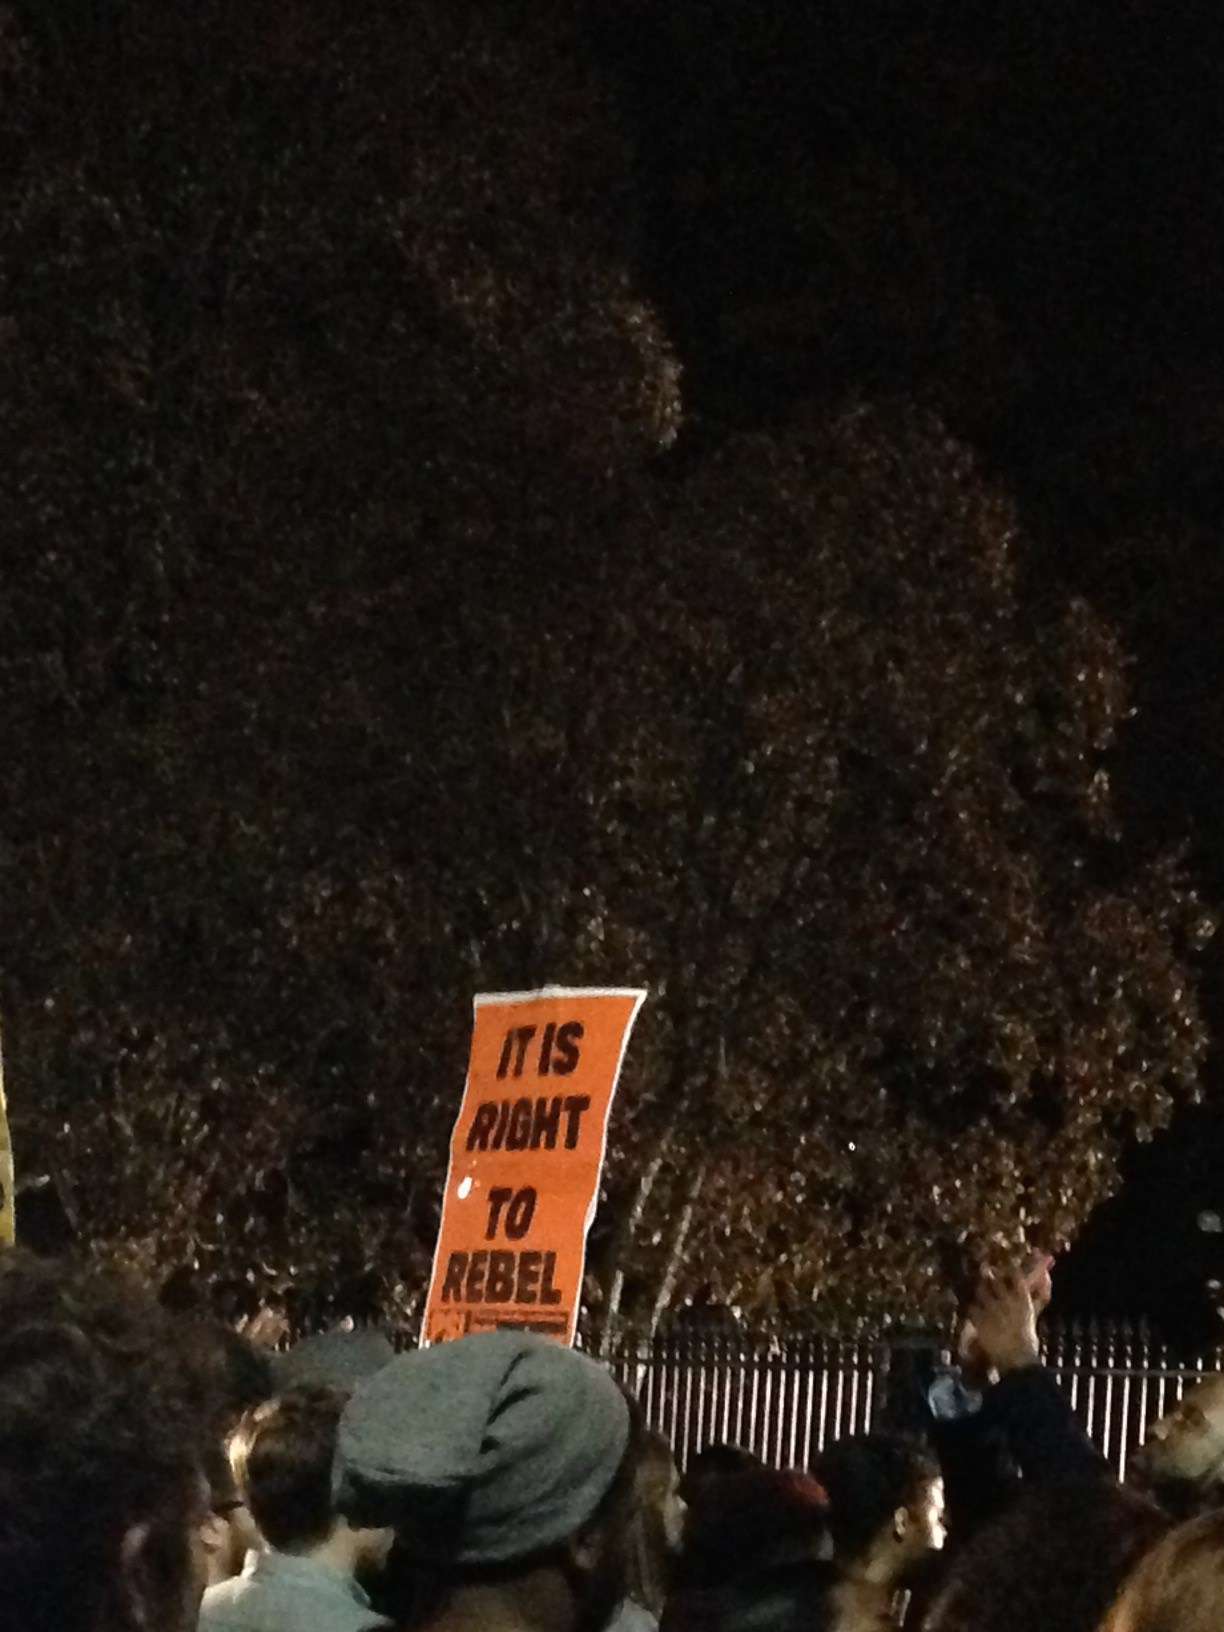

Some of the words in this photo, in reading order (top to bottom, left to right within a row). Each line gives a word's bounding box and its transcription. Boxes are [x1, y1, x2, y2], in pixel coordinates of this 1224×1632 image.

[496, 1025, 536, 1081] IT
[537, 1020, 584, 1077] IS
[466, 1094, 591, 1152] RIGHT
[486, 1185, 538, 1242] TO
[441, 1249, 563, 1305] REBEL
